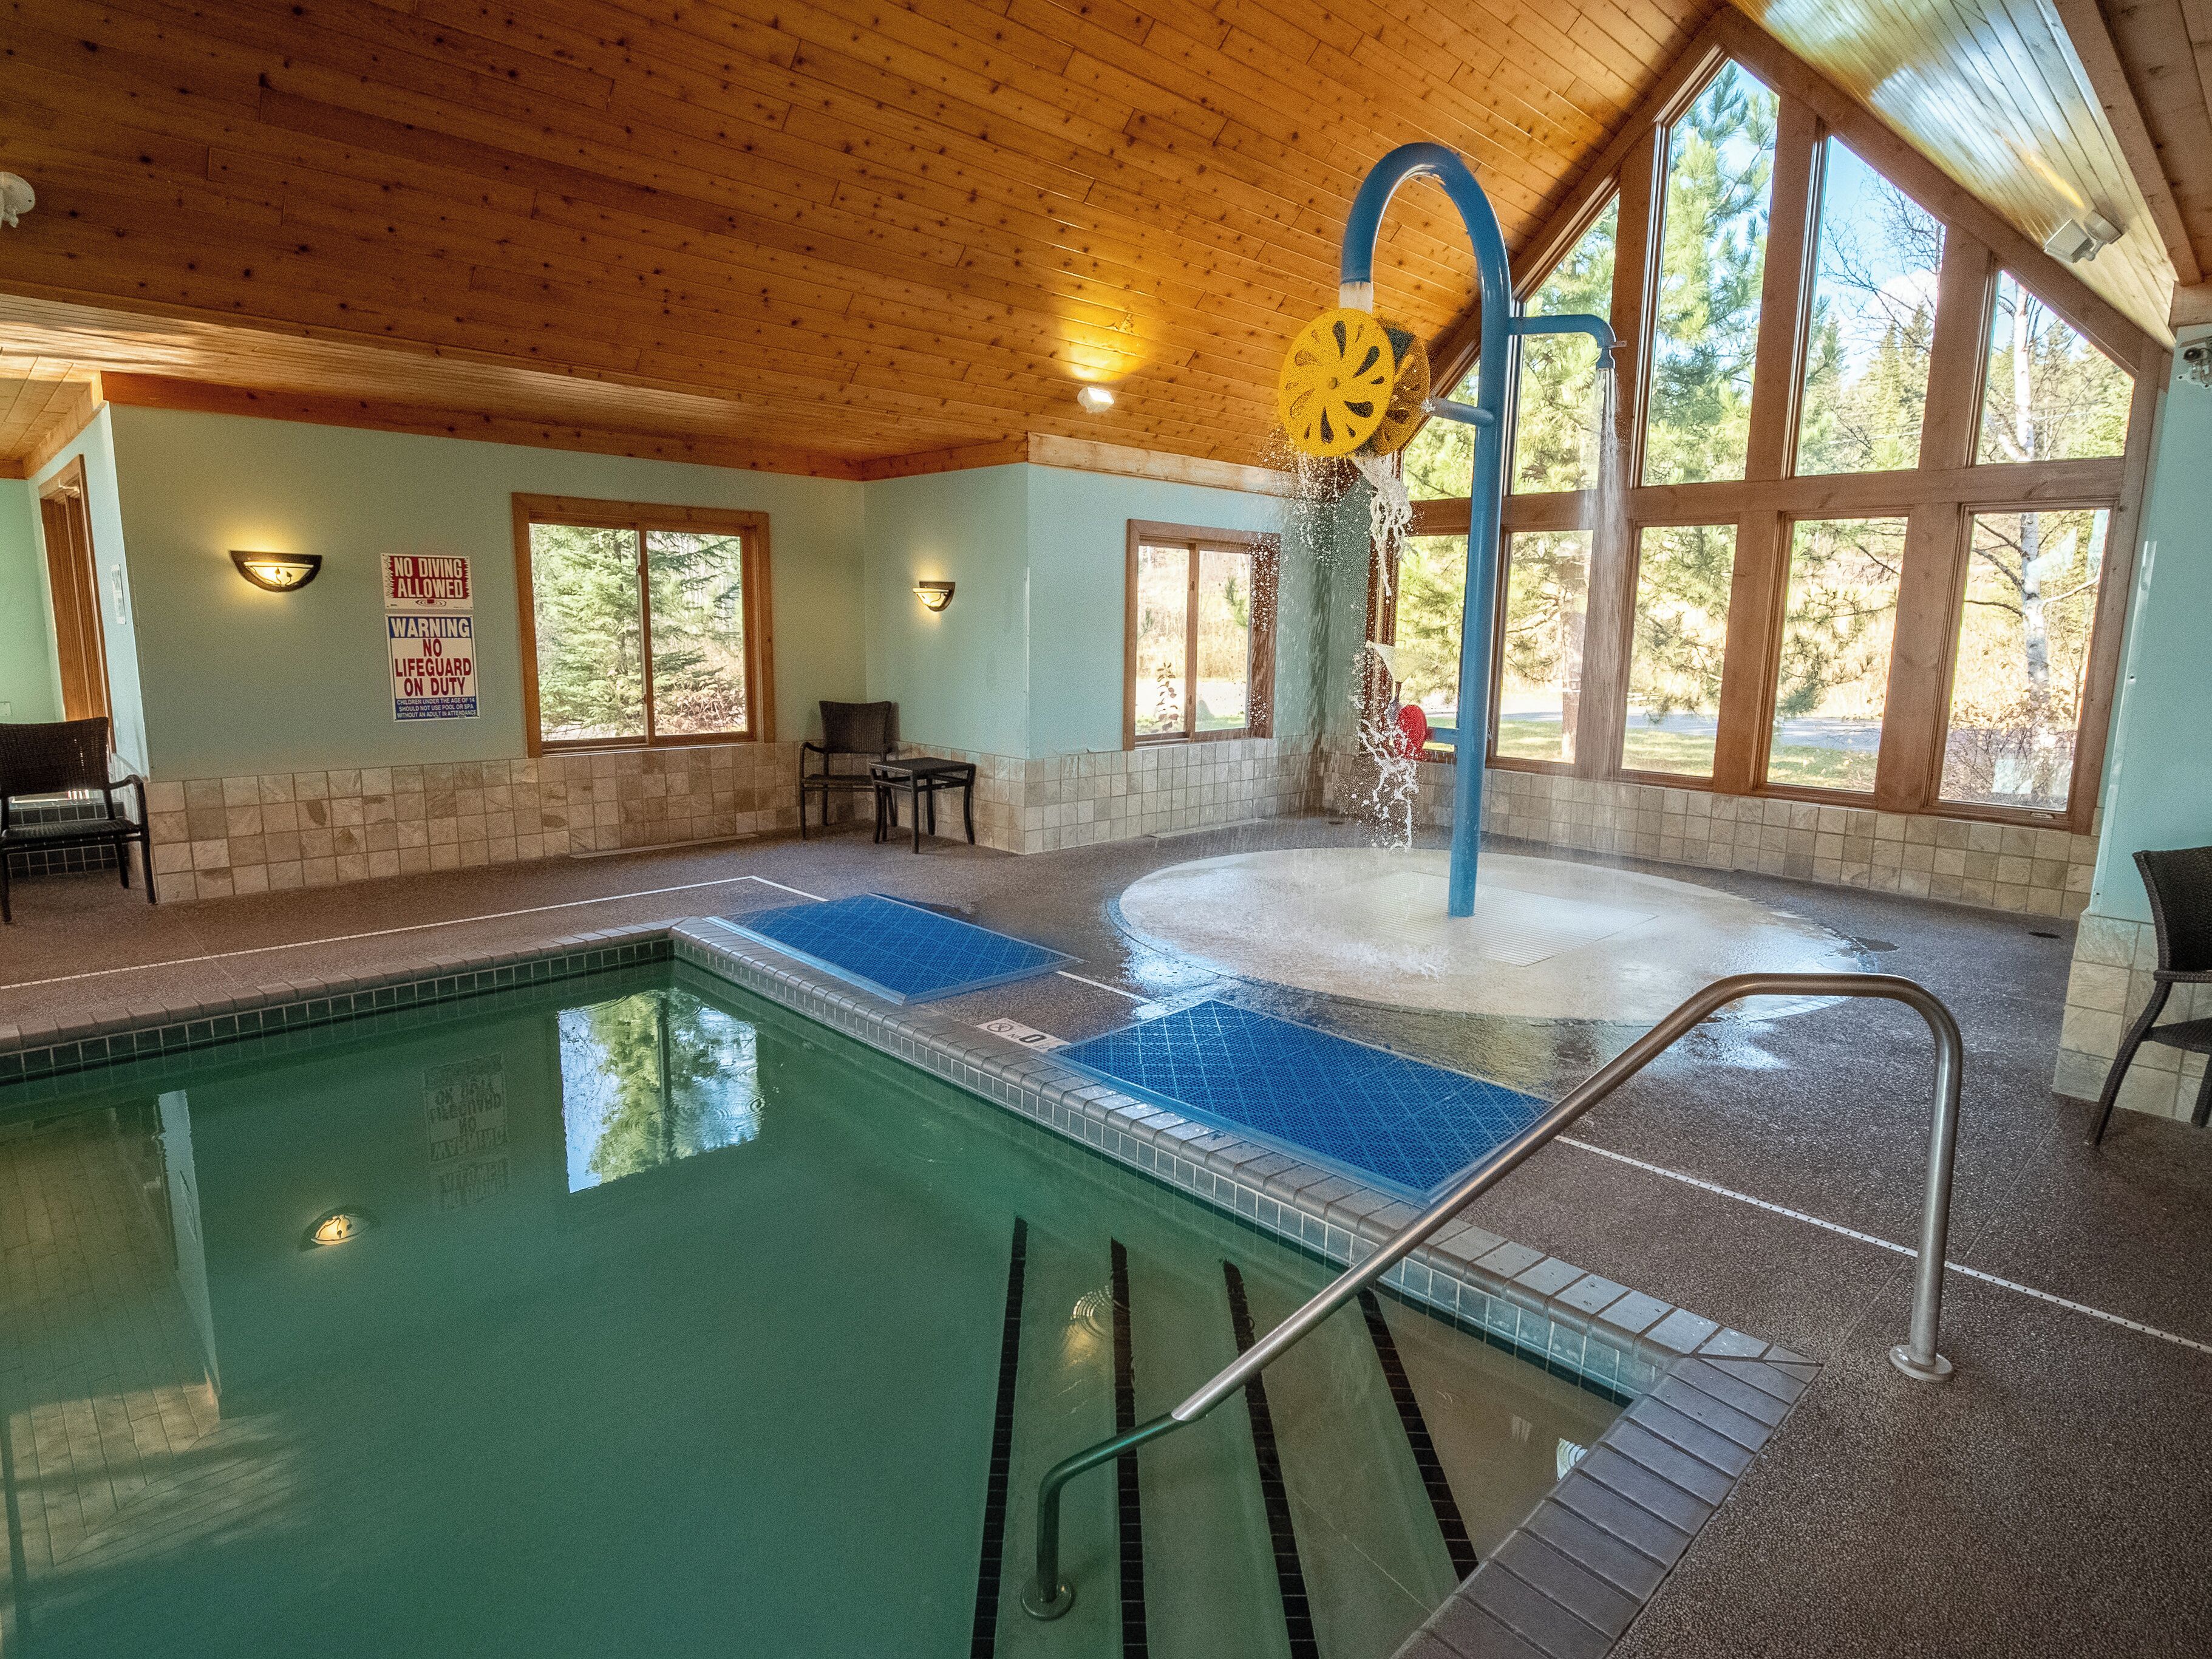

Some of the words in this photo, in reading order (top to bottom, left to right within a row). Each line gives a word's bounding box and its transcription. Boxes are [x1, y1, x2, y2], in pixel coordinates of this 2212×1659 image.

[394, 557, 413, 577] NO
[418, 557, 463, 578] DIVING
[398, 578, 464, 598] ALLOWED
[390, 618, 470, 637] WARNING
[423, 638, 442, 657] NO
[395, 658, 472, 677] LIFEGUARD
[404, 678, 423, 697] ON
[430, 677, 466, 696] DUTY
[1018, 1034, 1047, 1043] 0
